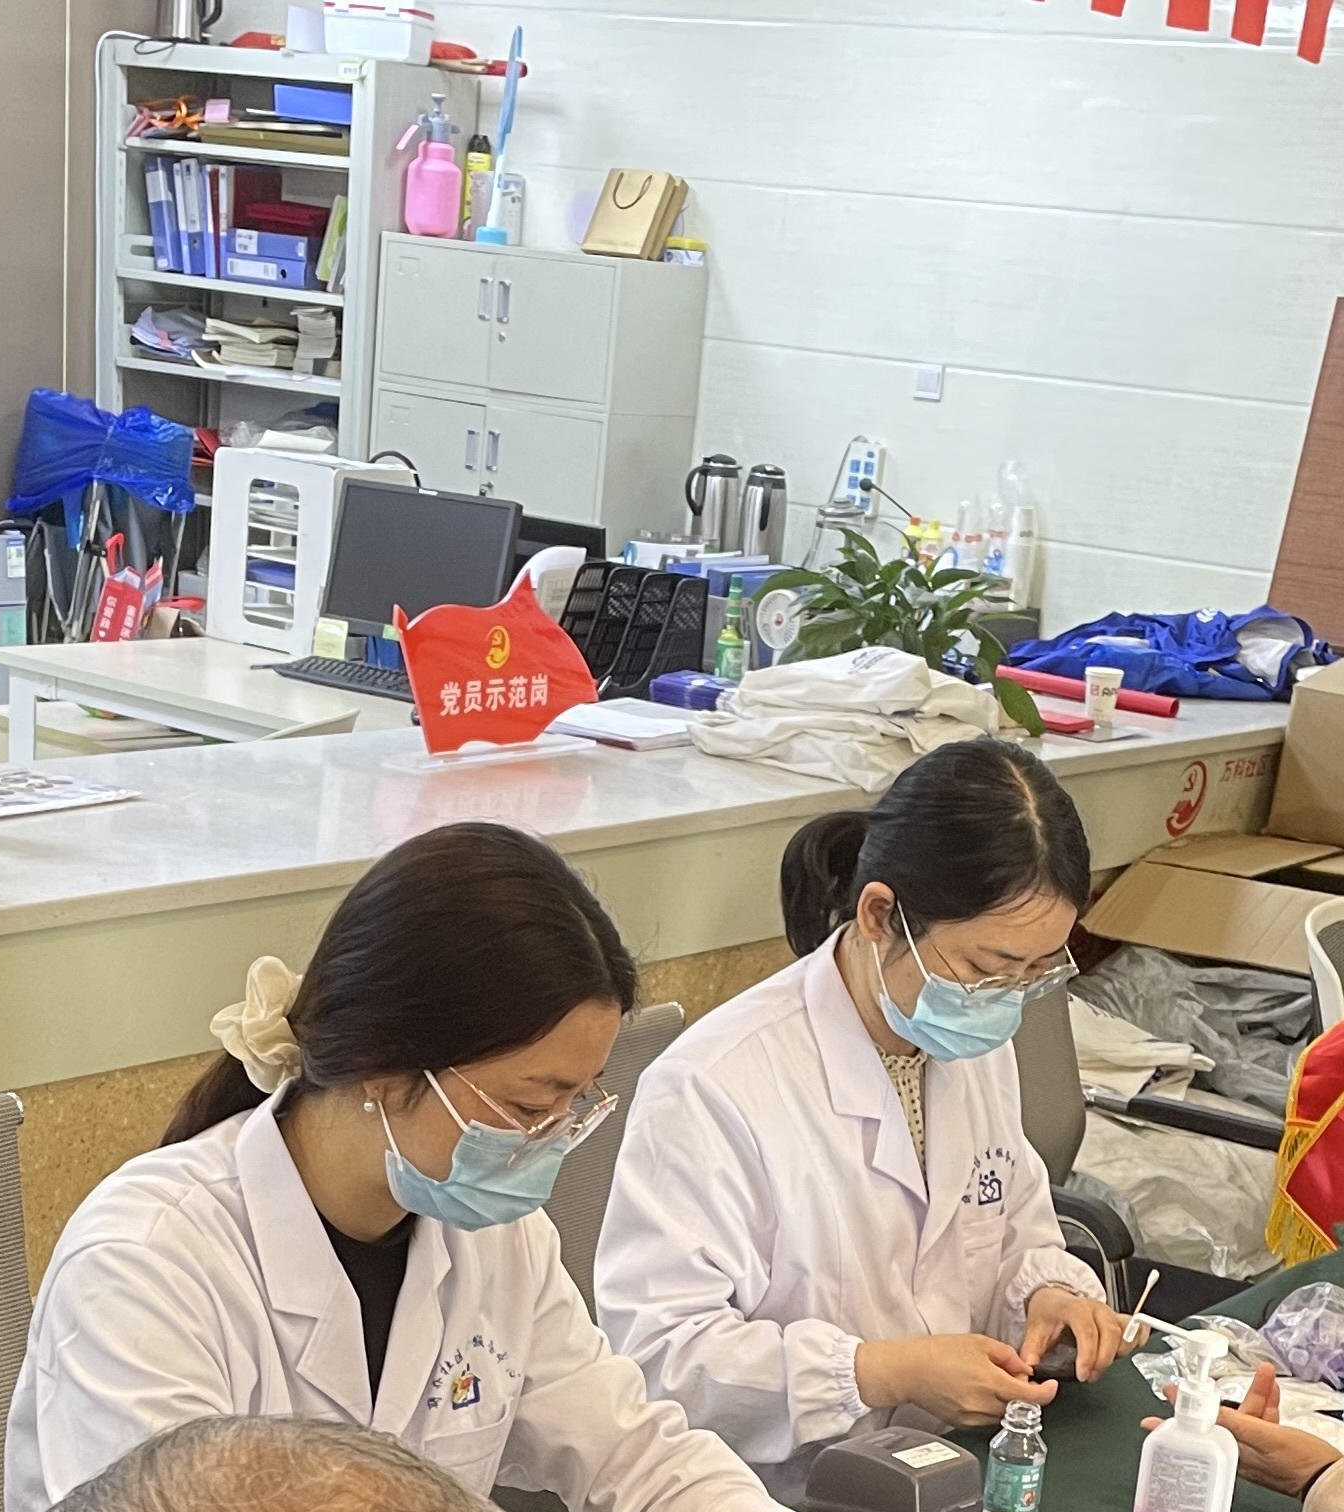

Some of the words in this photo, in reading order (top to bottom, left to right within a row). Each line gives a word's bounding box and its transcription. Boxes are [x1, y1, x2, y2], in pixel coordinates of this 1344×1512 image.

[439, 673, 549, 717] 党员示范岗
